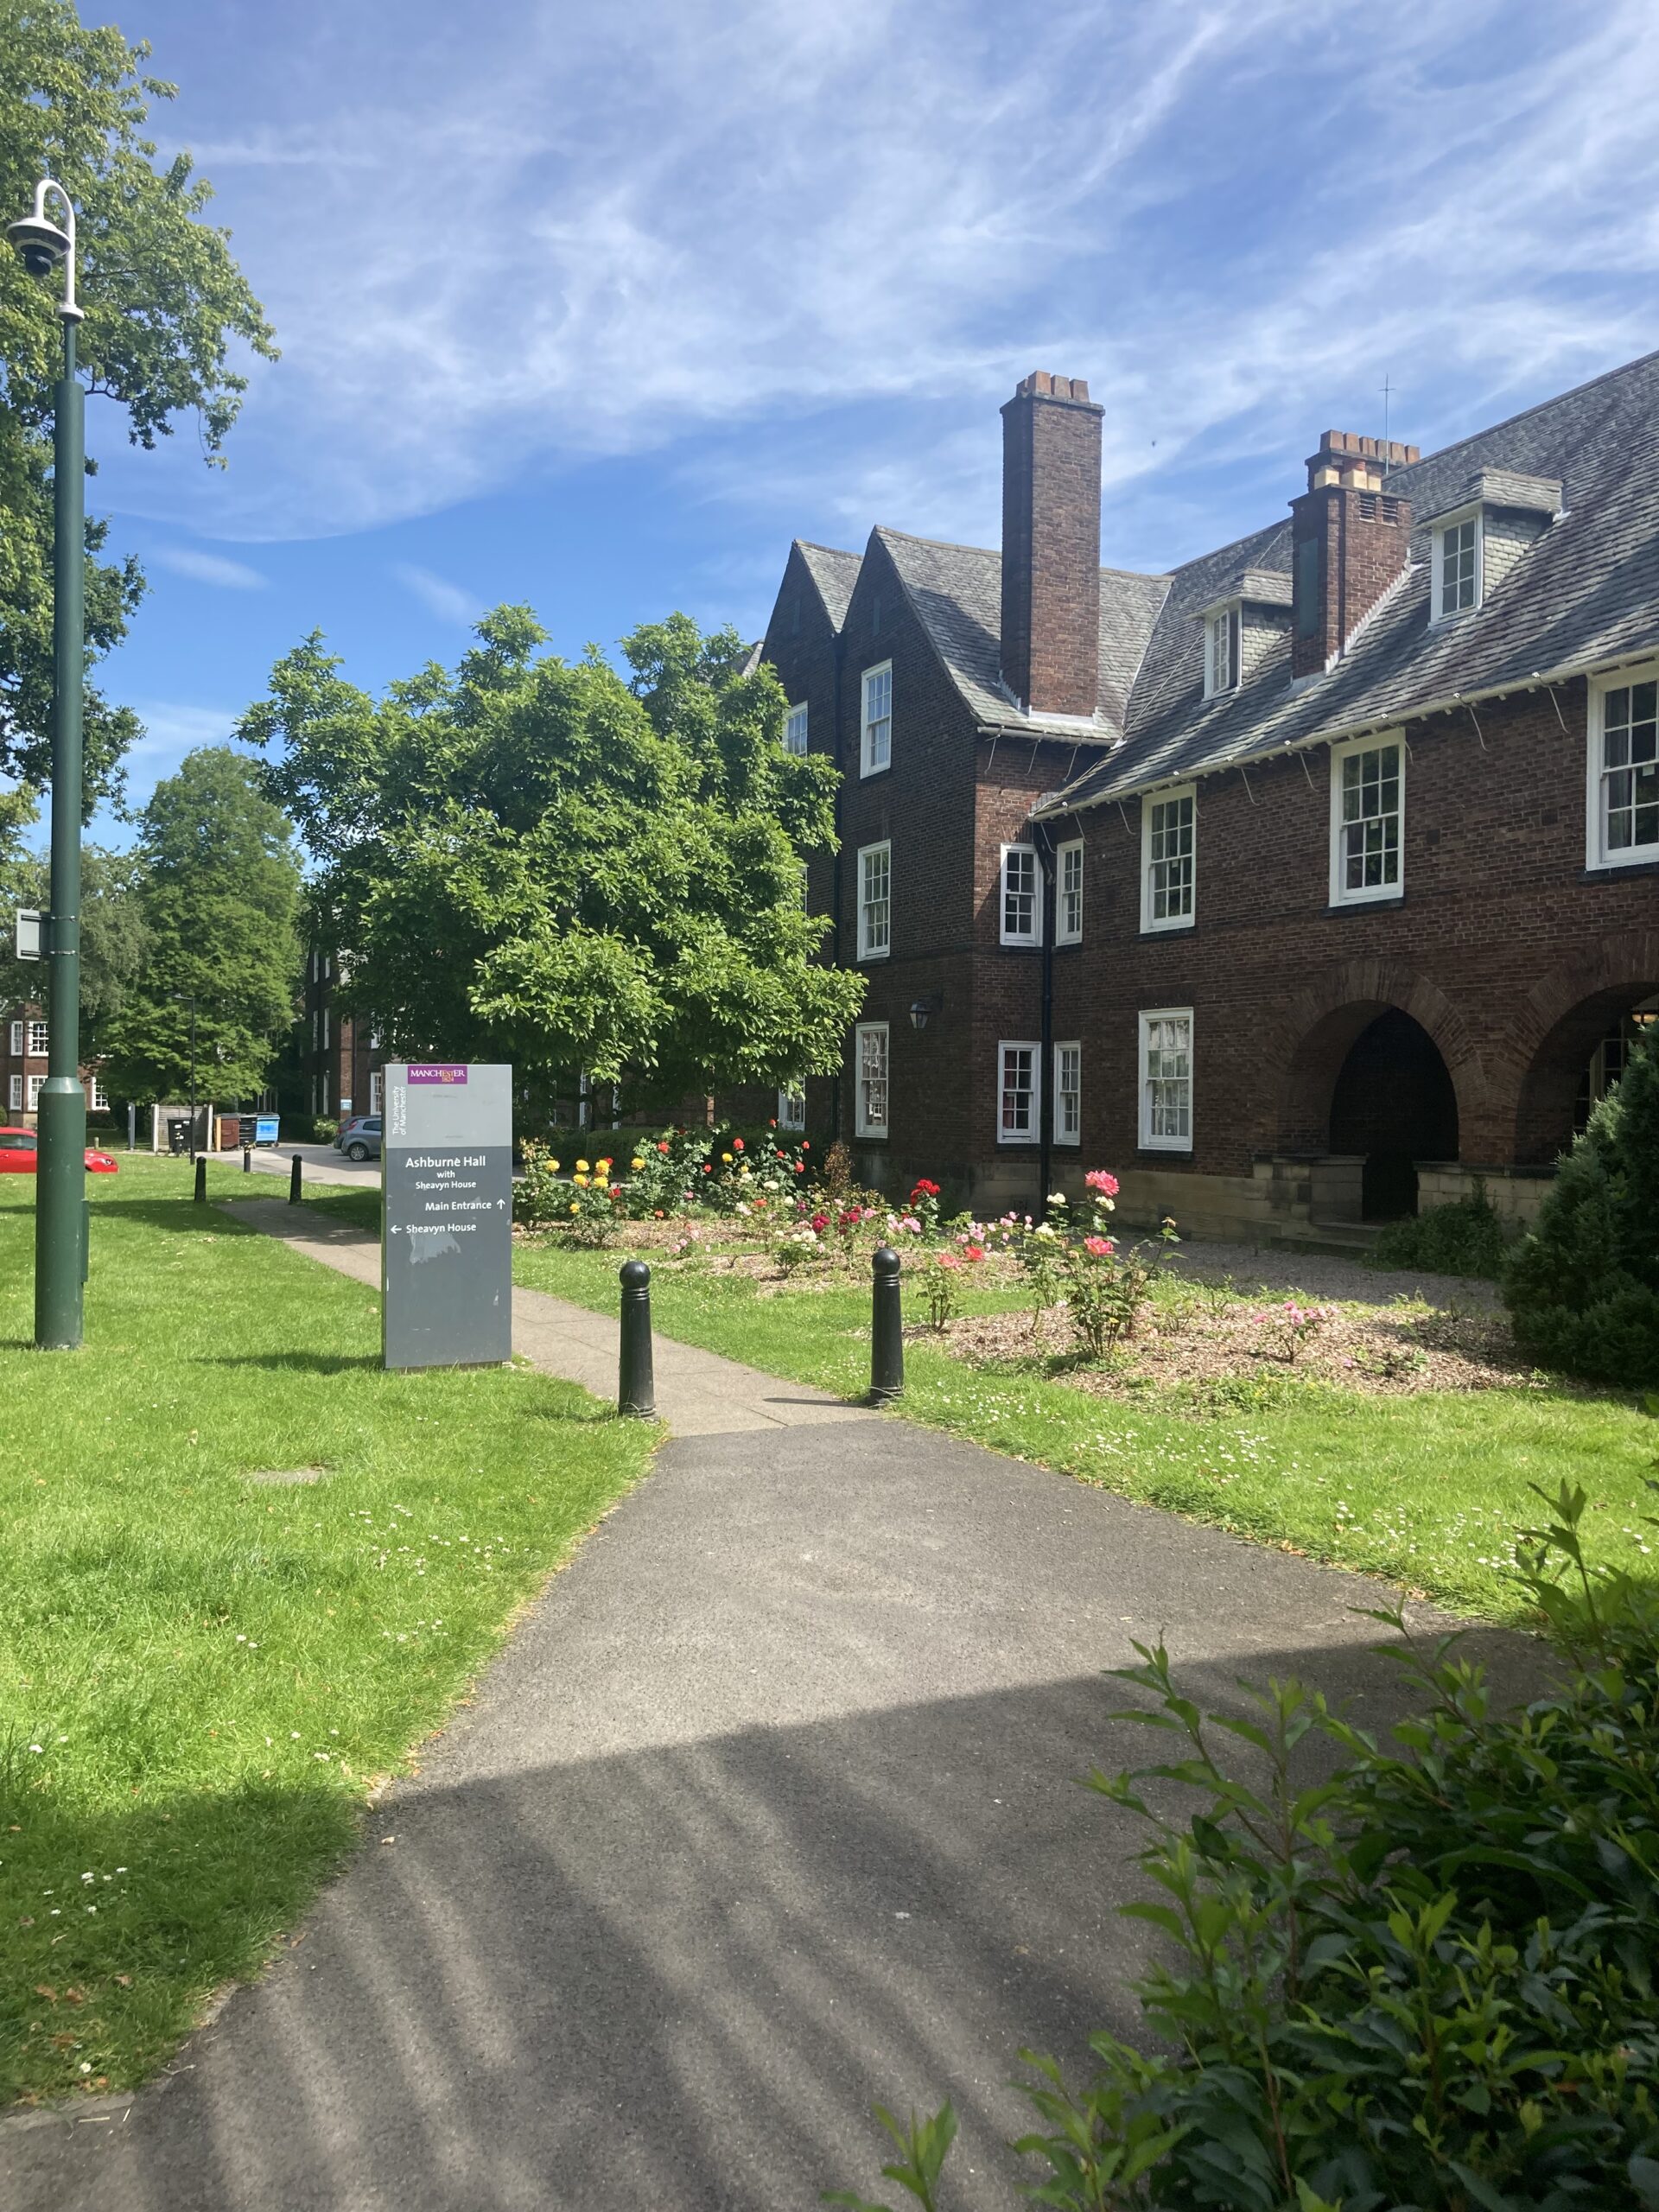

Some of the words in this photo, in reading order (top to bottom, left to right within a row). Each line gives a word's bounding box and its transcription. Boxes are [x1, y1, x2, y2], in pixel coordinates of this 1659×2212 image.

[392, 1086, 401, 1121] University
[399, 1127, 407, 1135] of
[405, 1156, 461, 1168] Ashburne
[464, 1155, 486, 1167] Hall
[436, 1170, 455, 1178] with
[416, 1181, 450, 1190] Sheavyn
[451, 1180, 477, 1189] House
[425, 1202, 449, 1211] Main
[451, 1201, 492, 1210] Entrance
[406, 1224, 445, 1235] Sheavyn
[447, 1223, 477, 1232] House
